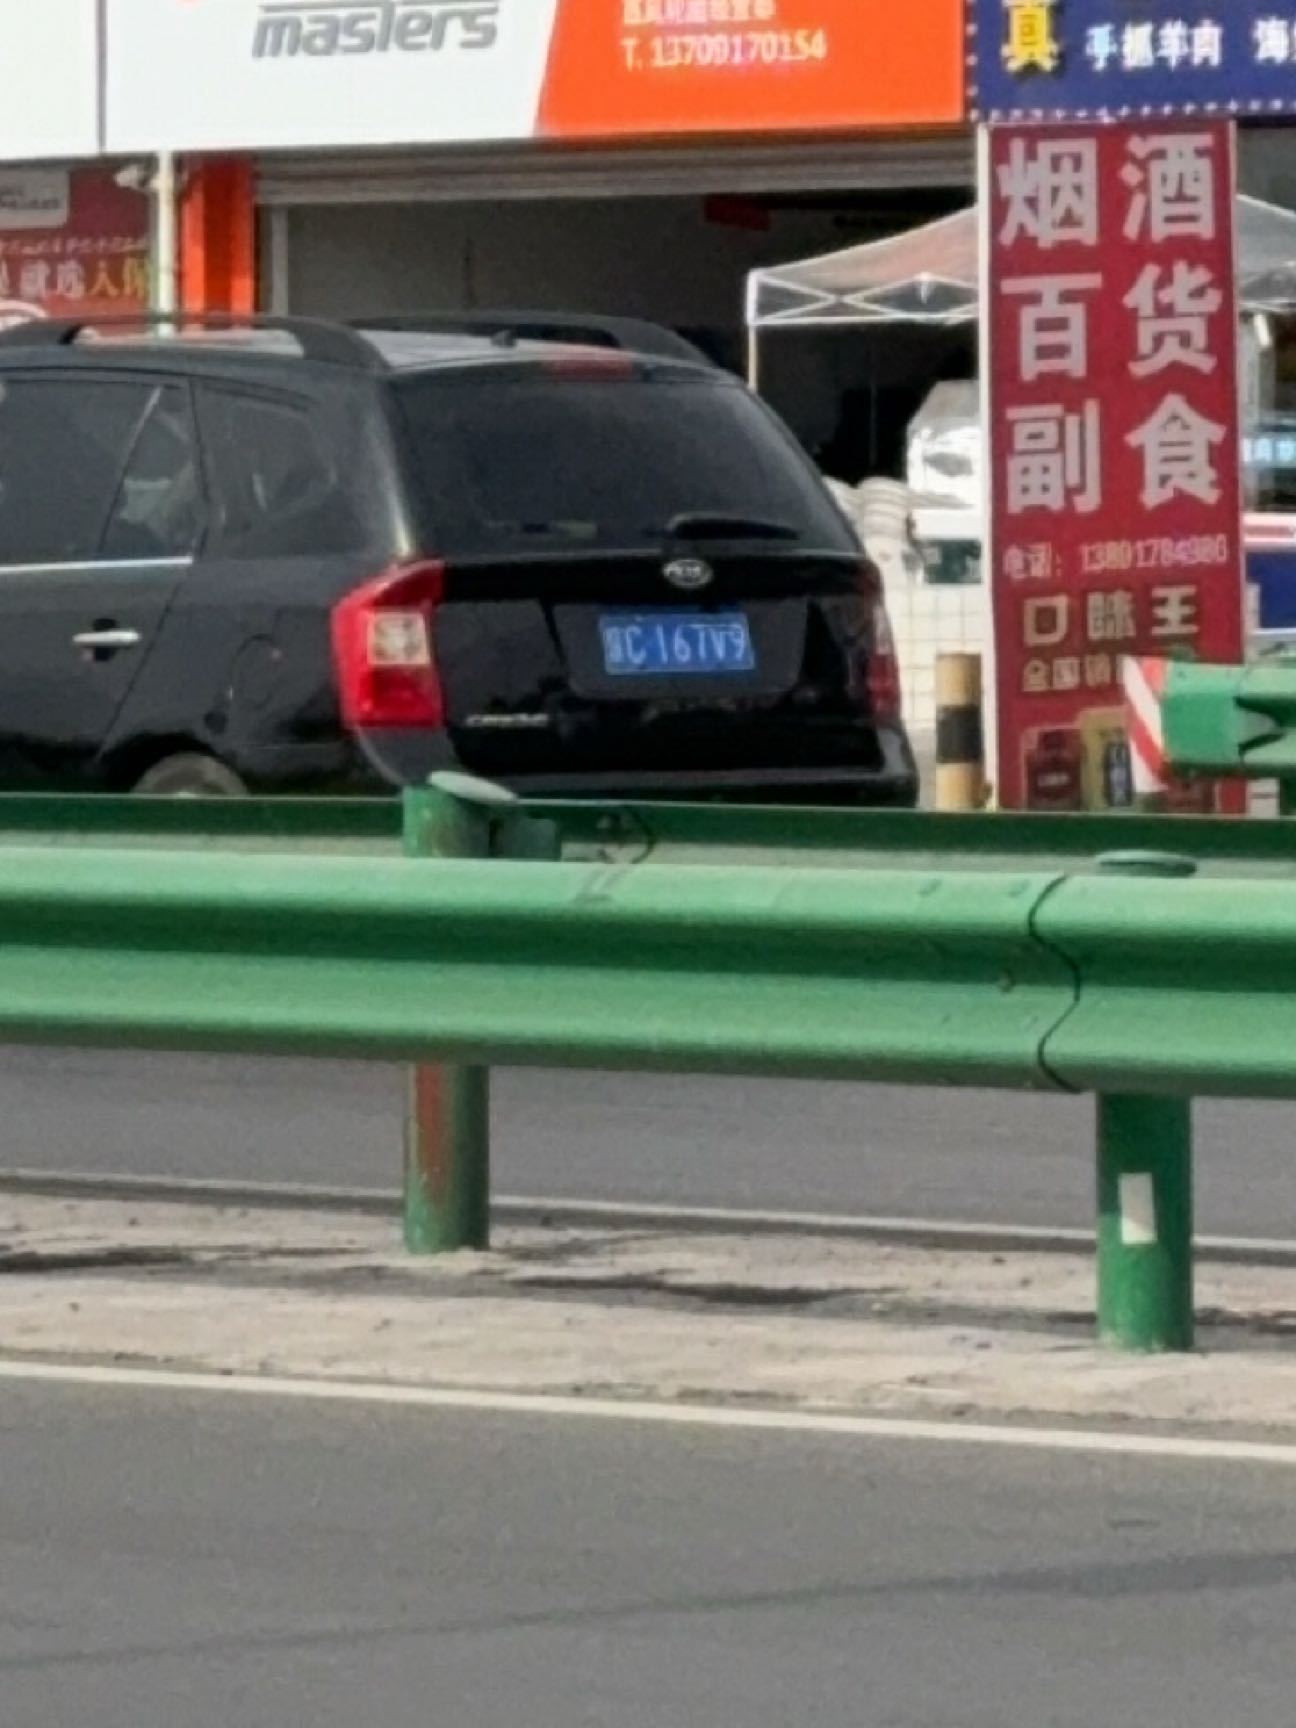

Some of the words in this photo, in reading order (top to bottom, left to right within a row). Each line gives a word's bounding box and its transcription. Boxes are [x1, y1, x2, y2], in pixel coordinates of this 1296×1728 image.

[1086, 18, 1223, 71] 手抓羊肉
[996, 133, 1216, 248] 烟酒
[1000, 260, 1223, 382] 百货
[1005, 392, 1227, 514] 副食
[1023, 585, 1198, 647] 口味王
[1022, 653, 1126, 692] 全国销
